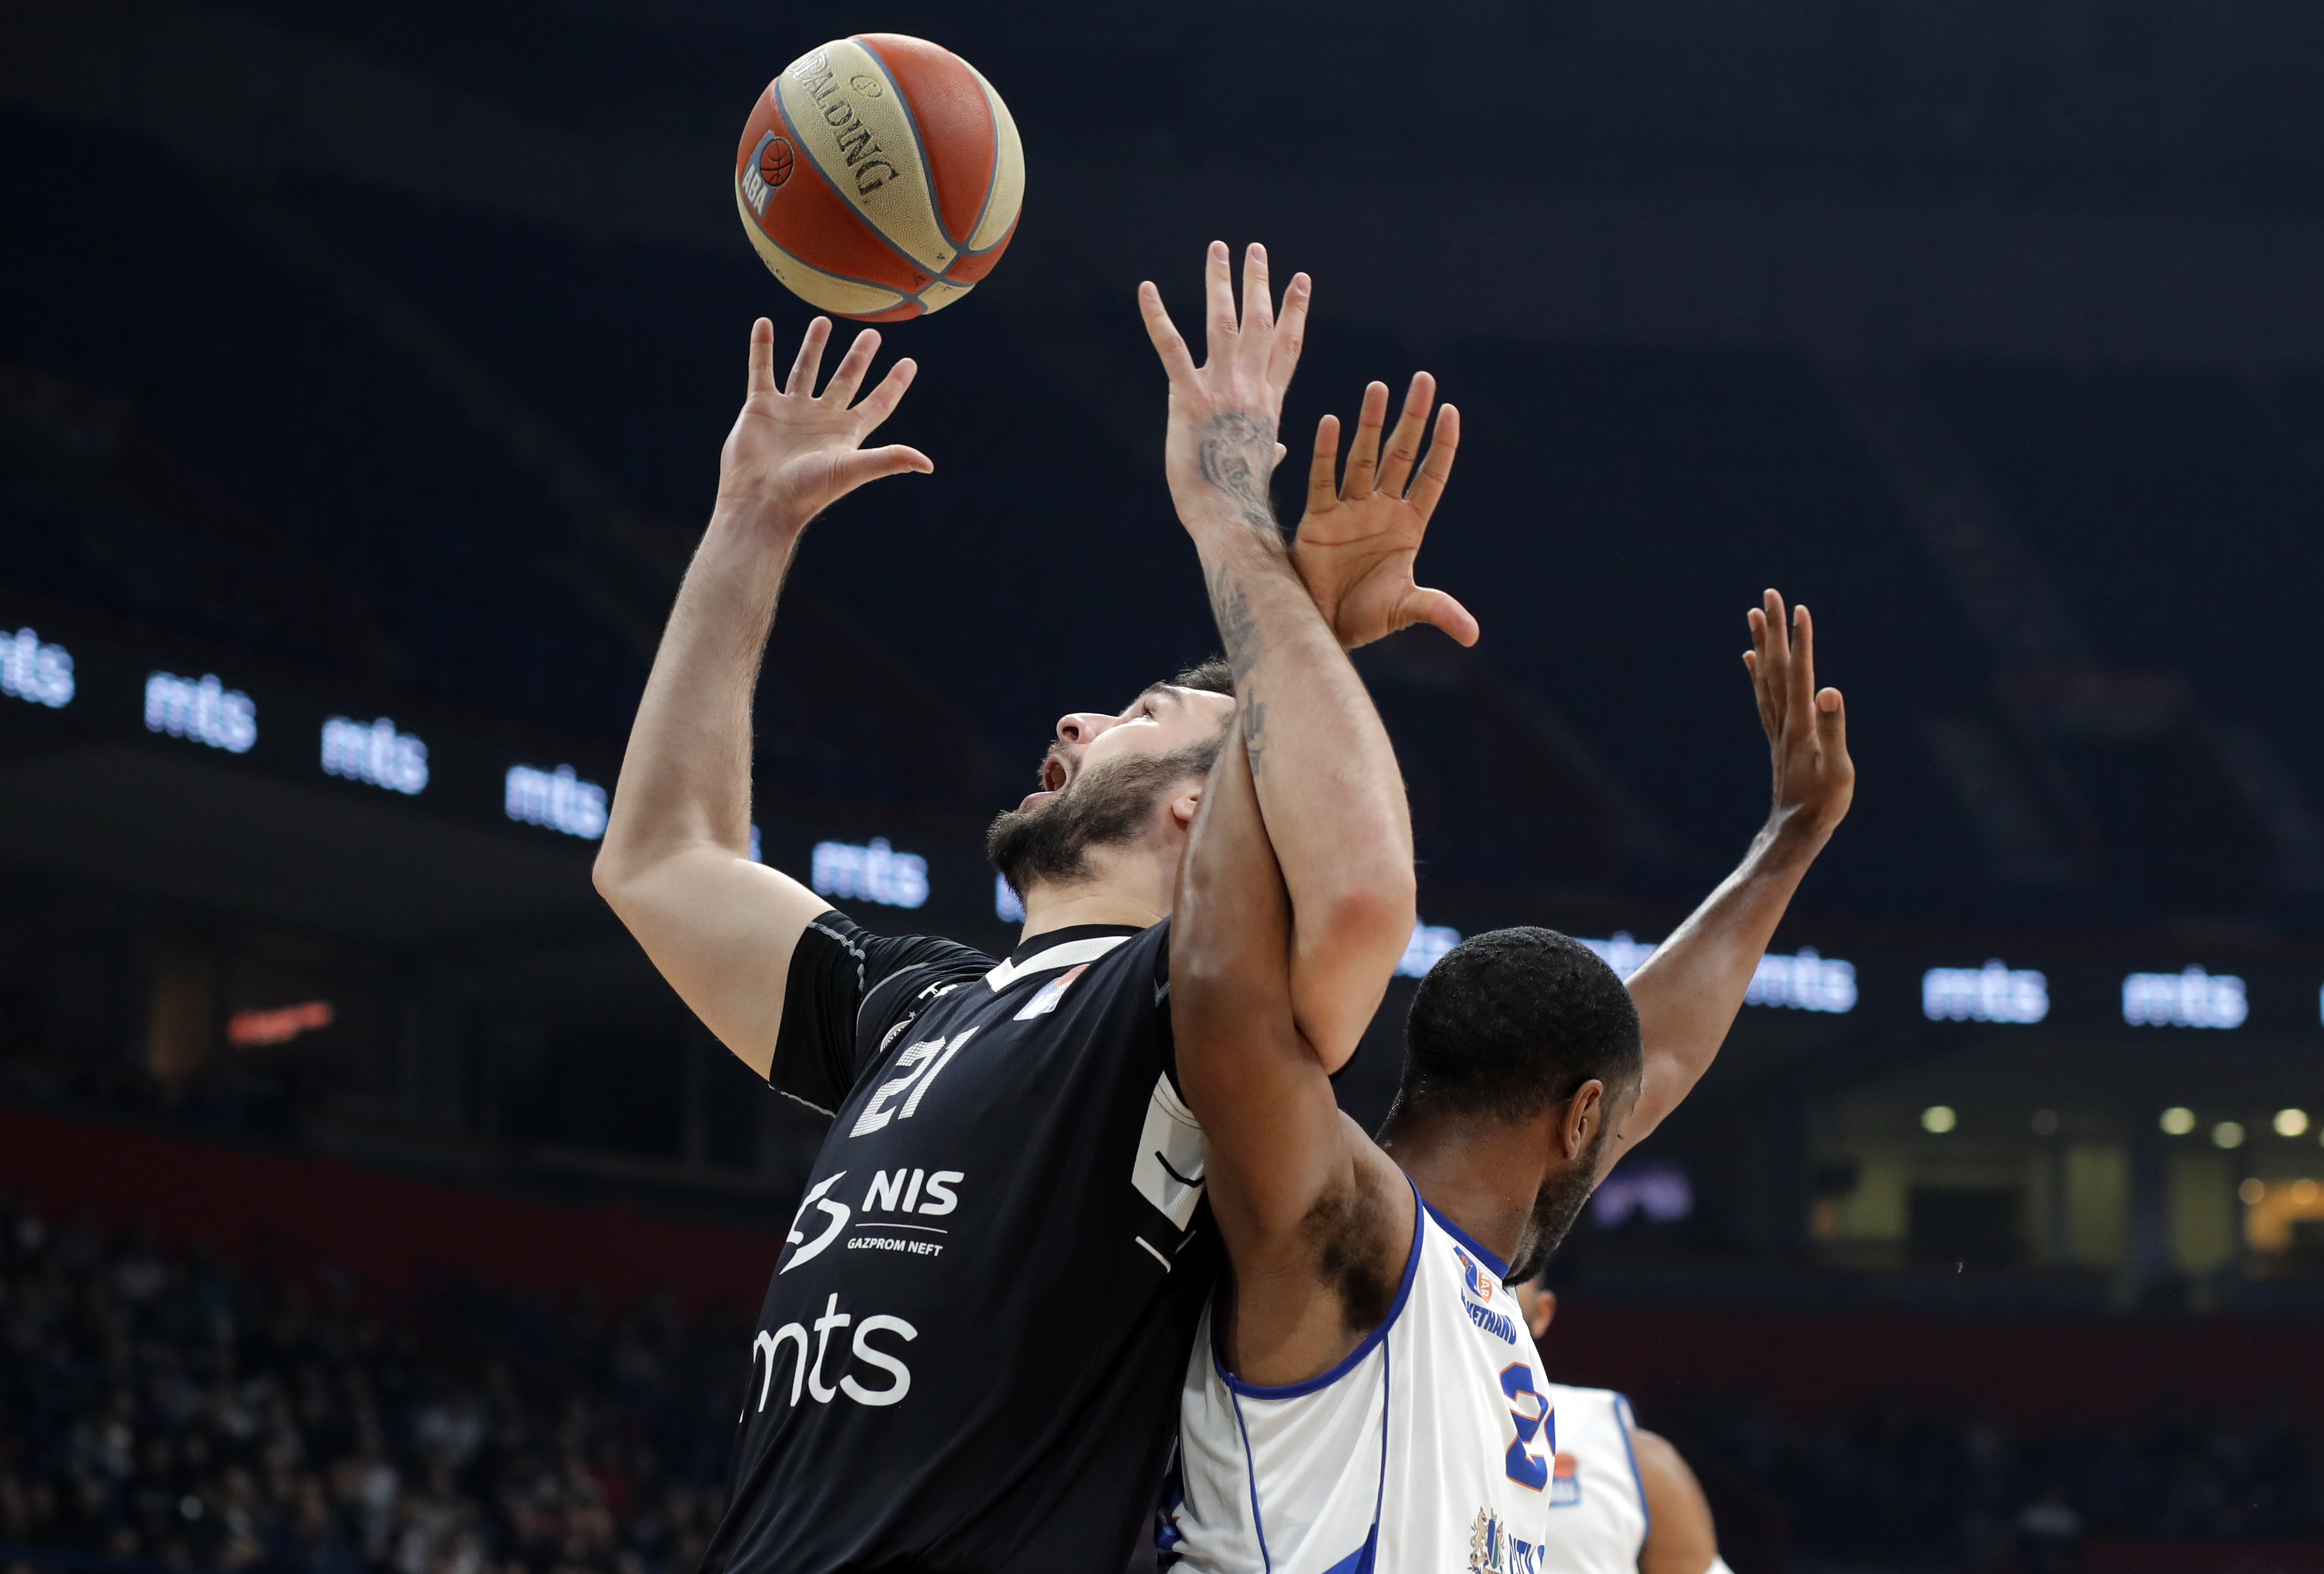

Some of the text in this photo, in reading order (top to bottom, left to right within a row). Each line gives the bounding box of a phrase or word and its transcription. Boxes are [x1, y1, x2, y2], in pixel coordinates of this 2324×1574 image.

[742, 163, 768, 215] ABA
[849, 1025, 980, 1138] 21
[862, 1168, 964, 1216] NIS
[847, 1237, 943, 1257] GAZPROM NEFT
[739, 1292, 918, 1423] mts
